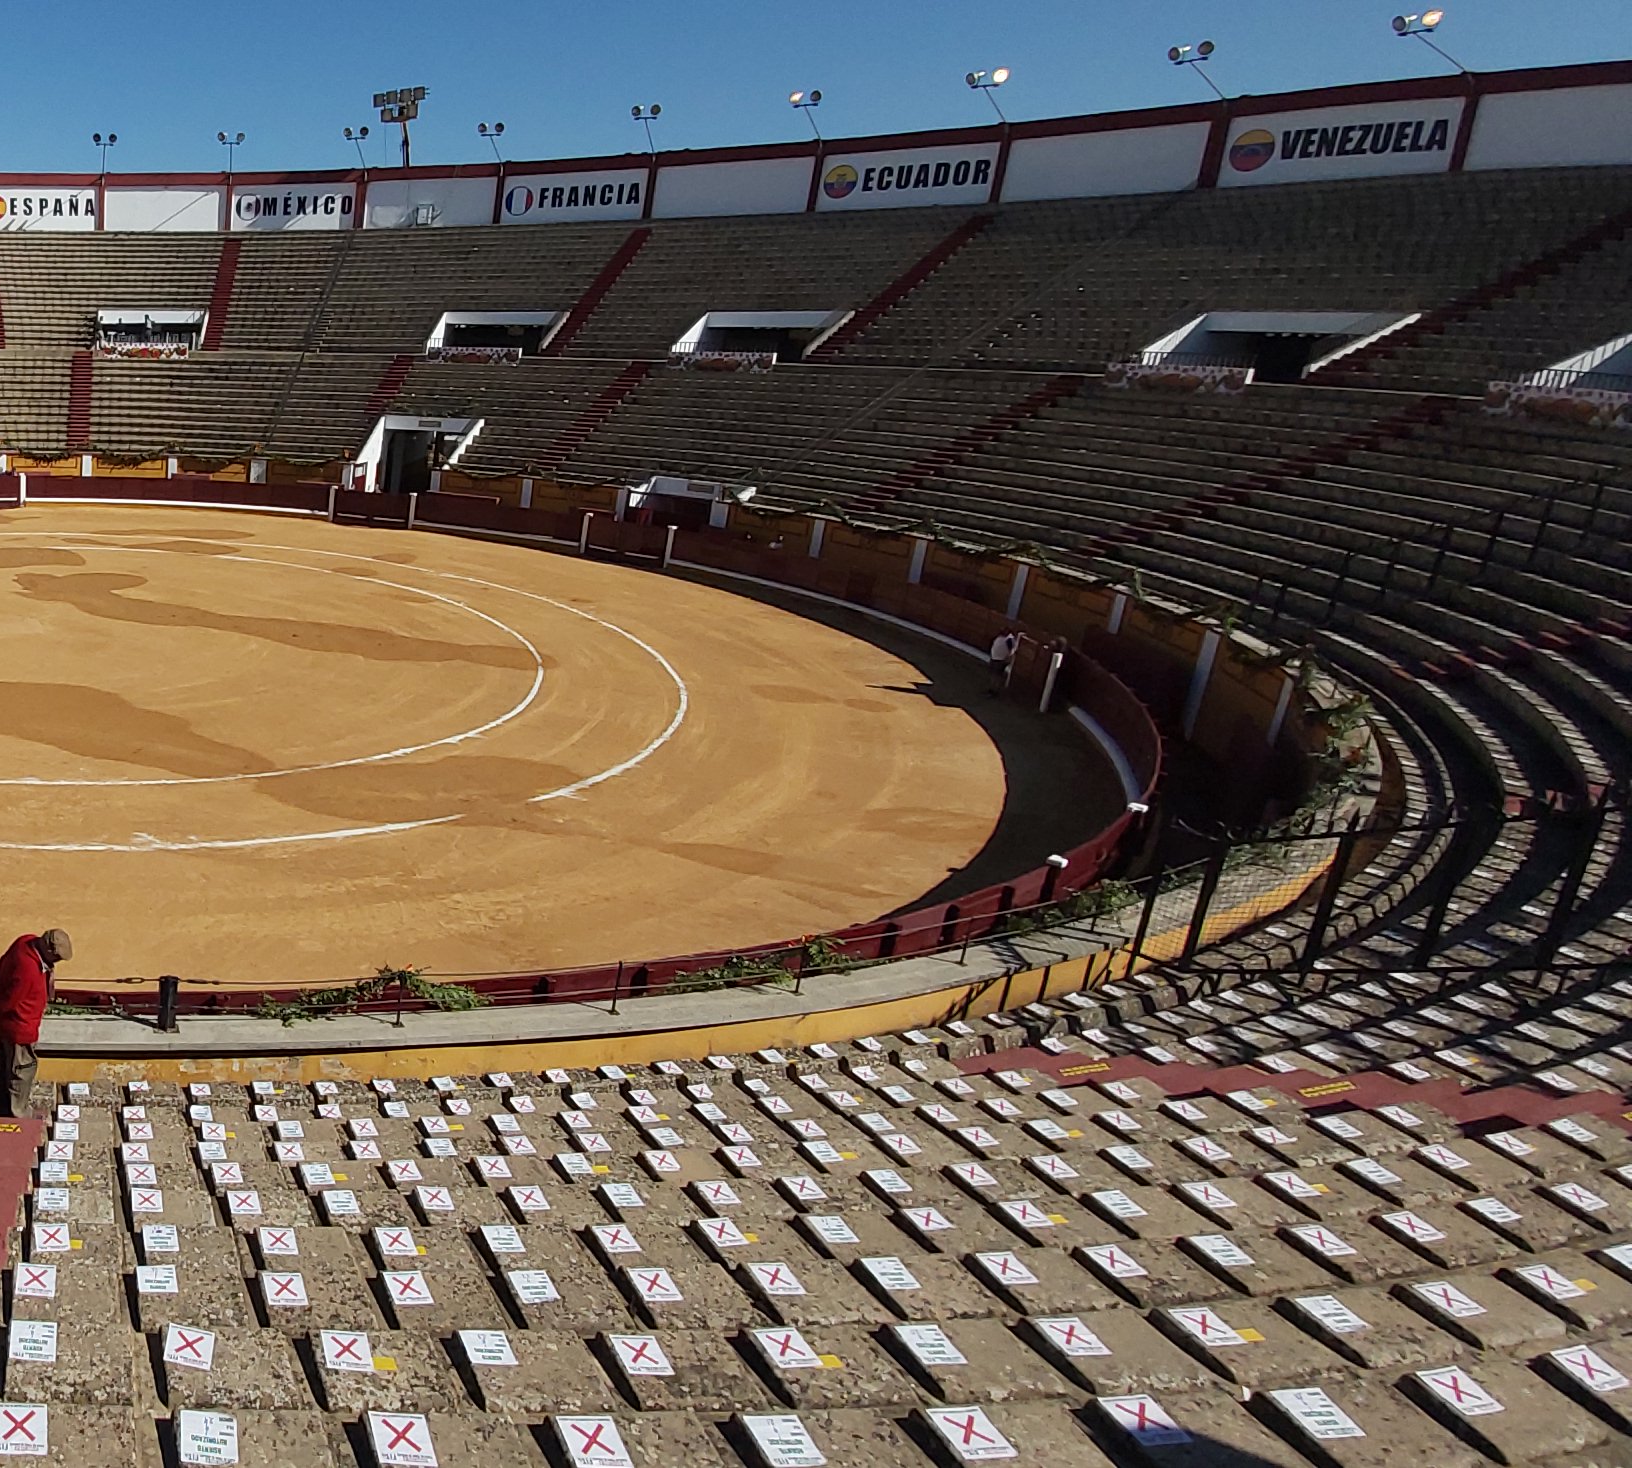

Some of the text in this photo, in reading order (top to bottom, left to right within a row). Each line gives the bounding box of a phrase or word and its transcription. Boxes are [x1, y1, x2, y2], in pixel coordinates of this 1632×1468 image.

[1280, 119, 1449, 160] VENEZUELA
[861, 159, 991, 192] ECUADOR
[10, 195, 95, 216] ESPAÑA
[262, 192, 353, 216] MÉXICO
[538, 182, 640, 208] FRANCIA
